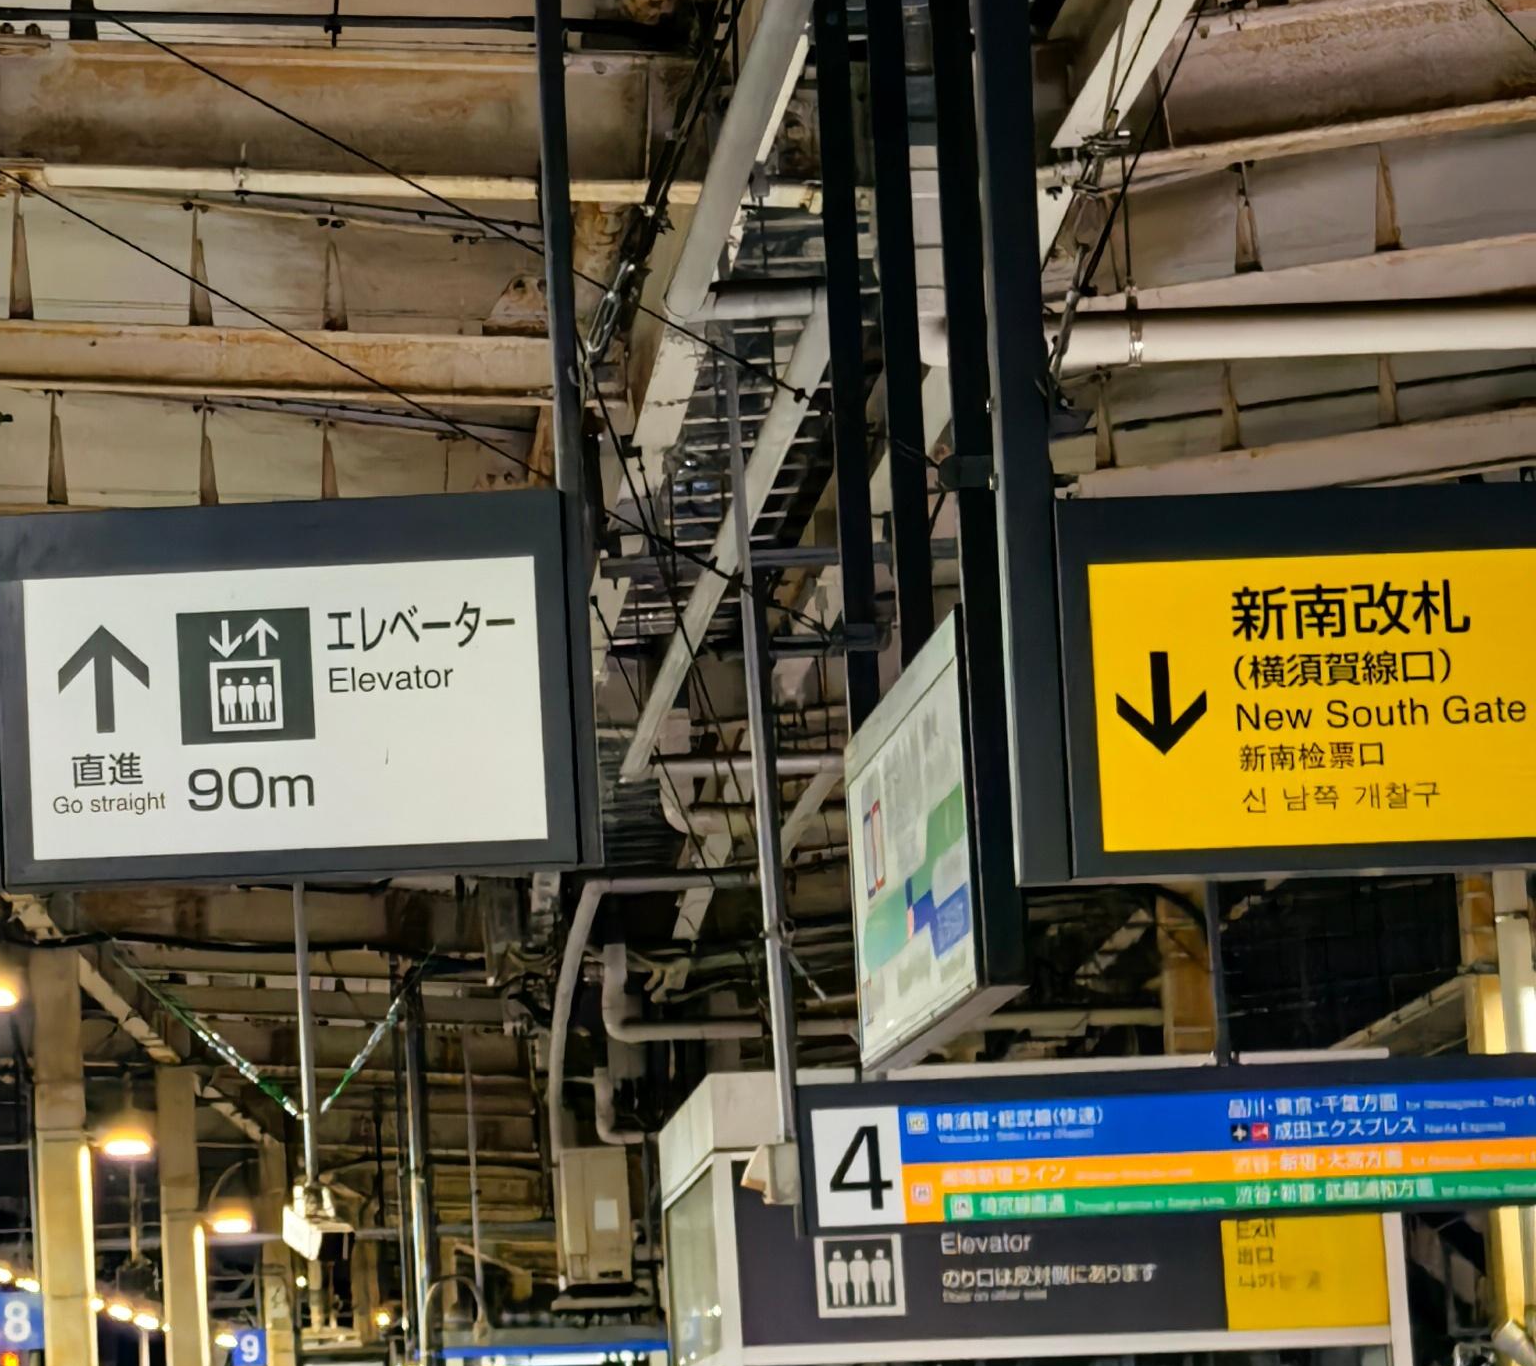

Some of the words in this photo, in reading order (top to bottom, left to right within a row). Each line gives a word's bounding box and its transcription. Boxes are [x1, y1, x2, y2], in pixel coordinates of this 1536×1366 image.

[326, 601, 515, 653] エレベーター
[1231, 579, 1471, 641] 新南改札
[329, 662, 454, 693] Elevator
[1236, 703, 1312, 731] New
[1326, 698, 1428, 729] South
[1443, 695, 1526, 724] Gate
[71, 753, 144, 787] 直進
[53, 796, 83, 814] Go
[90, 792, 166, 815] straight
[188, 766, 315, 811] 90m
[1242, 787, 1267, 813] 신
[1283, 784, 1340, 811] 남쪽
[1354, 781, 1441, 810] 개찰구
[829, 1125, 893, 1211] 4
[941, 1231, 1032, 1255] Elevator
[3, 1301, 32, 1343] 8
[240, 1335, 260, 1362] 9
